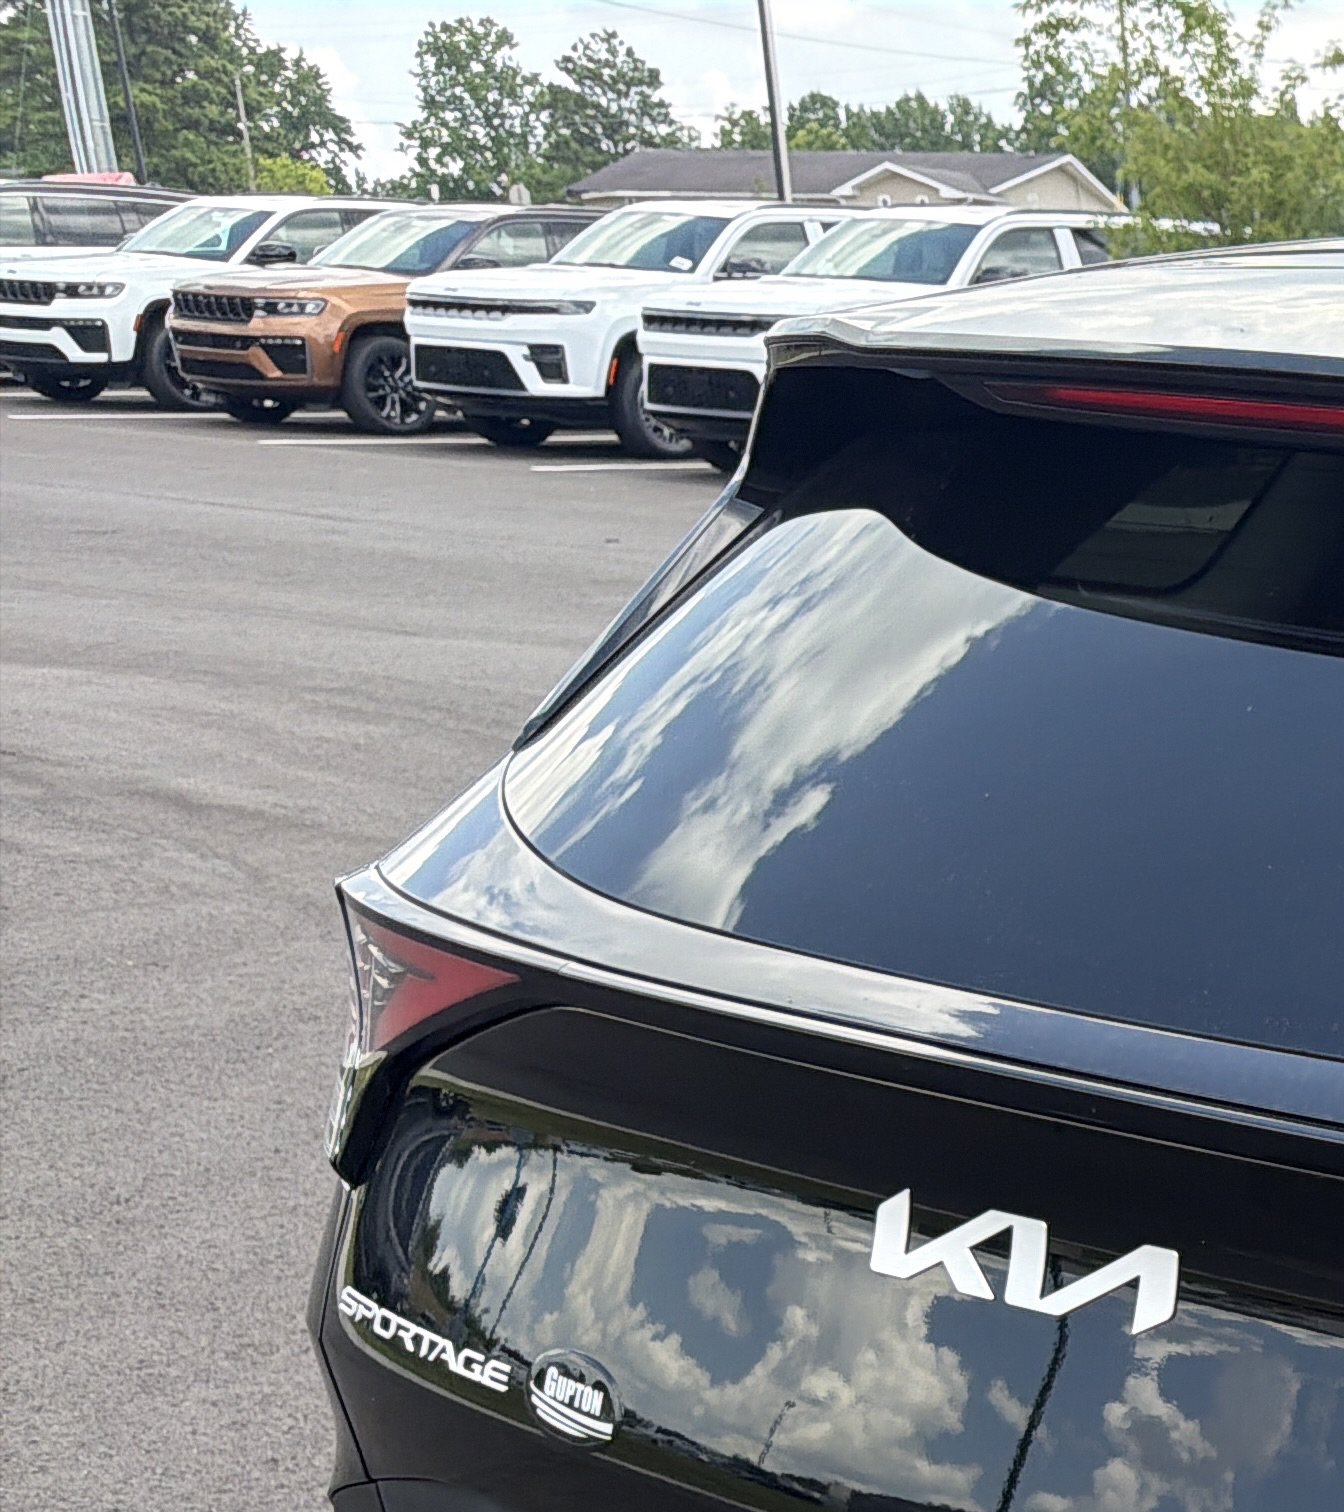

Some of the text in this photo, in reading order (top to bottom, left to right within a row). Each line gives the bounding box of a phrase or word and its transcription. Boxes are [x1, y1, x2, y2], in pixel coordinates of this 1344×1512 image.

[868, 1187, 1181, 1335] KIA
[338, 1285, 513, 1393] SPORTAGE
[543, 1366, 605, 1418] GUPTON
